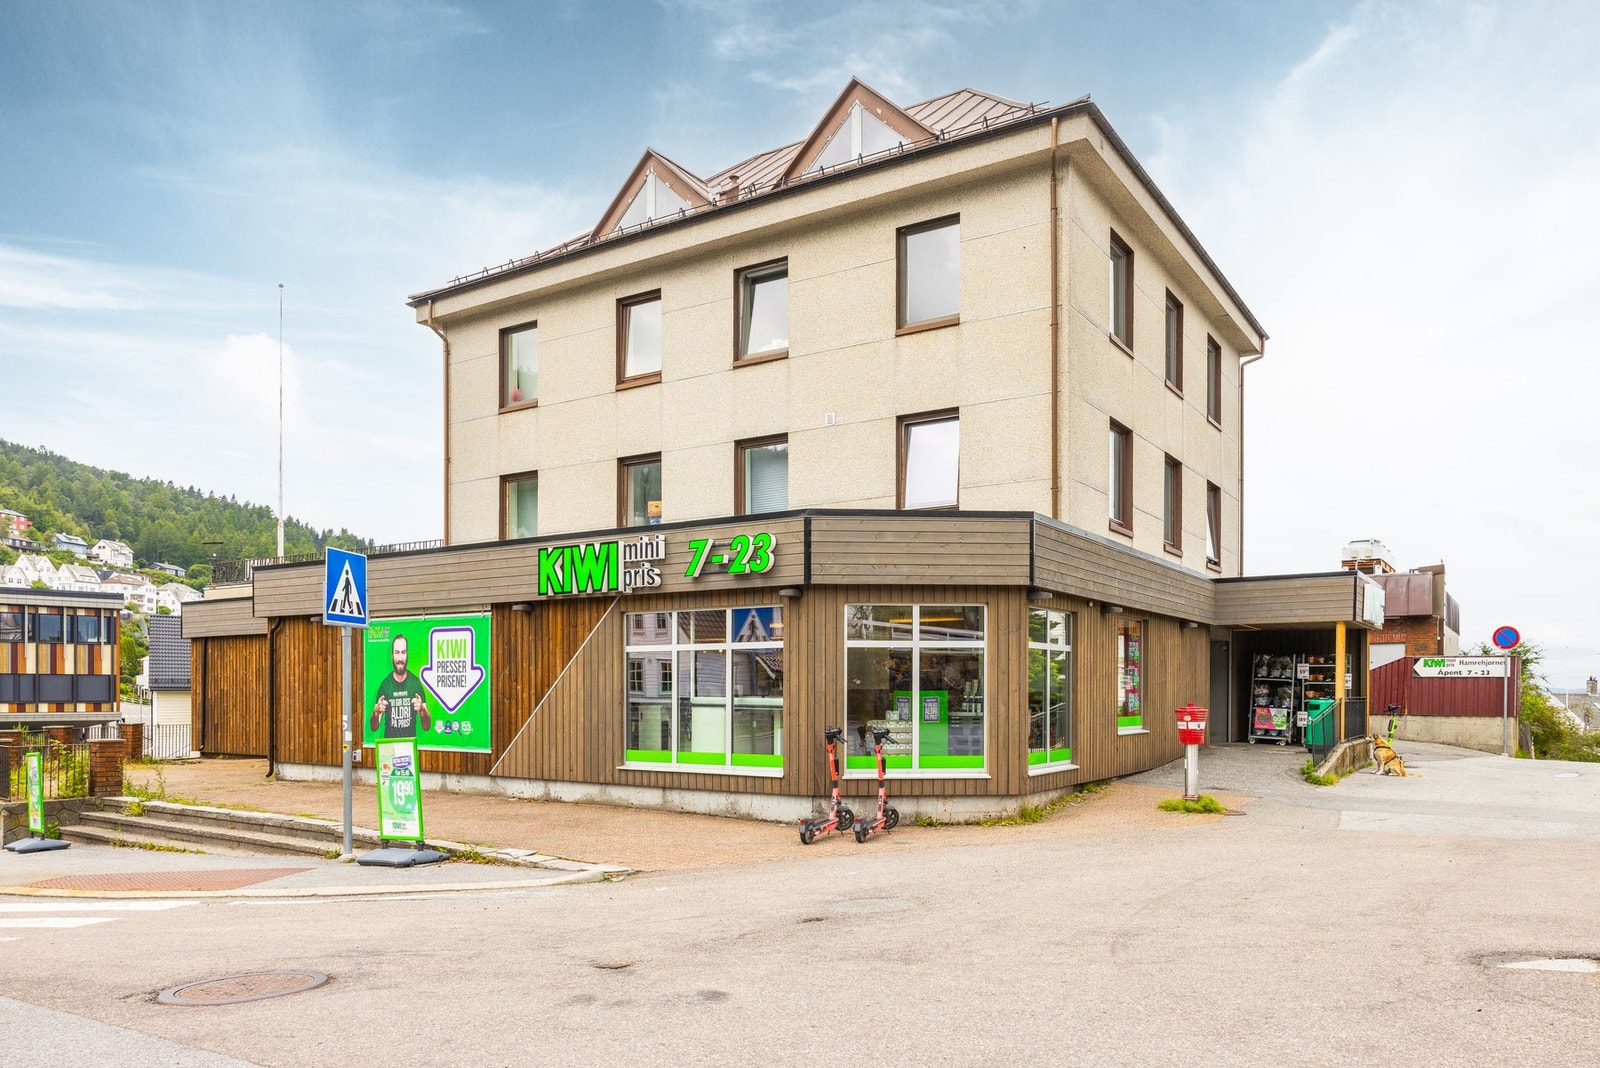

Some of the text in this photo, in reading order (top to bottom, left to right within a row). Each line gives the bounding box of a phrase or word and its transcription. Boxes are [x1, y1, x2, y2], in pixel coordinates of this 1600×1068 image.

[624, 534, 663, 560] mini
[538, 541, 622, 596] KIWI
[624, 562, 660, 593] pris
[437, 639, 467, 659] KIWI
[437, 660, 467, 674] PRESSER
[1423, 658, 1446, 668] KIWI
[437, 675, 467, 688] PRISENE!
[391, 706, 411, 720] ALDRI
